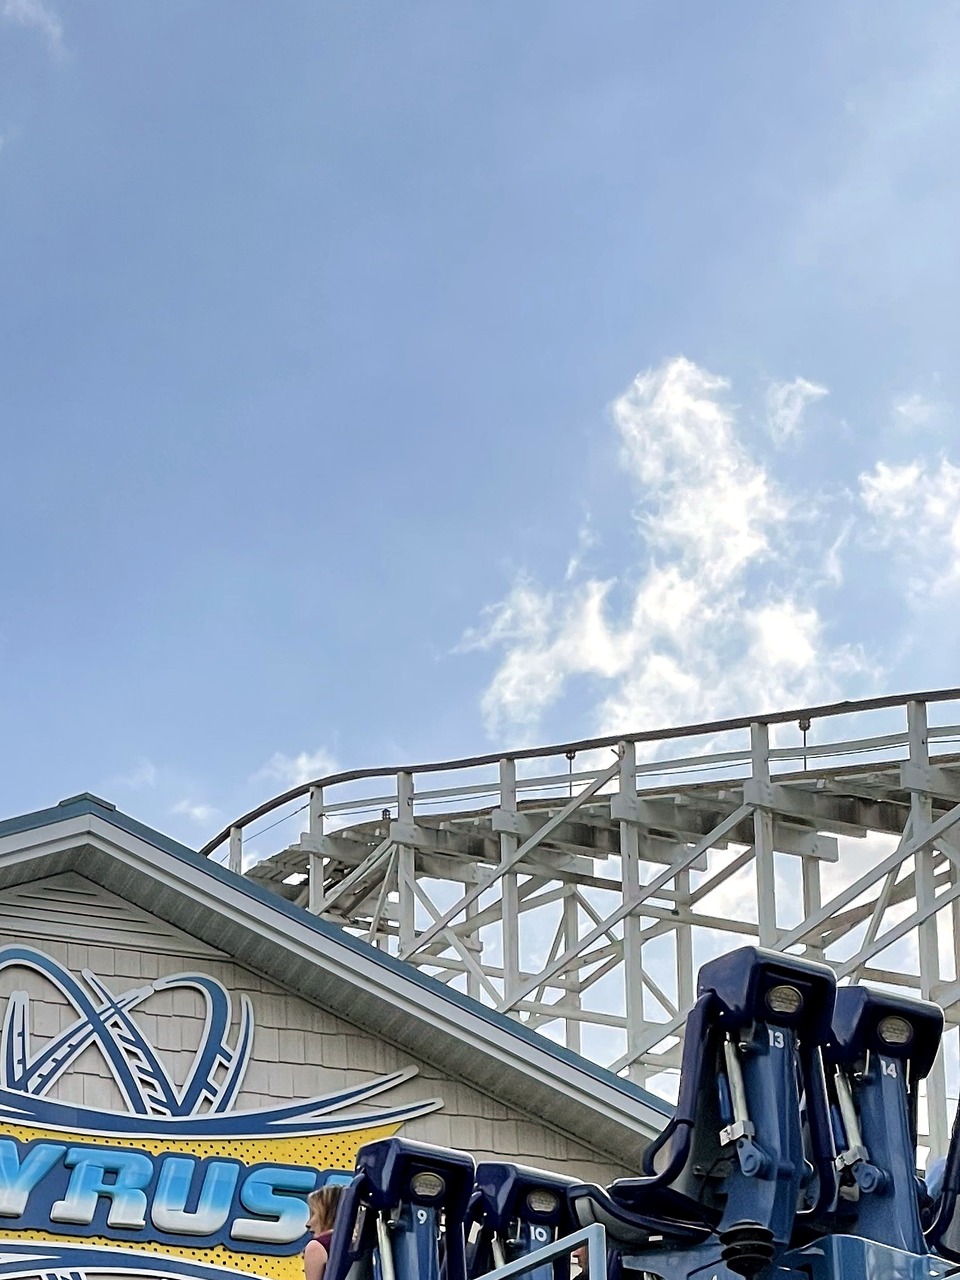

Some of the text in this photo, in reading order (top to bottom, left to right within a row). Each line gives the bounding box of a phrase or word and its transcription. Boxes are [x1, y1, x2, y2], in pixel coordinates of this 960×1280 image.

[768, 1029, 784, 1049] 13
[880, 1060, 897, 1079] 14
[417, 1209, 428, 1225] 9
[530, 1225, 547, 1242] 10
